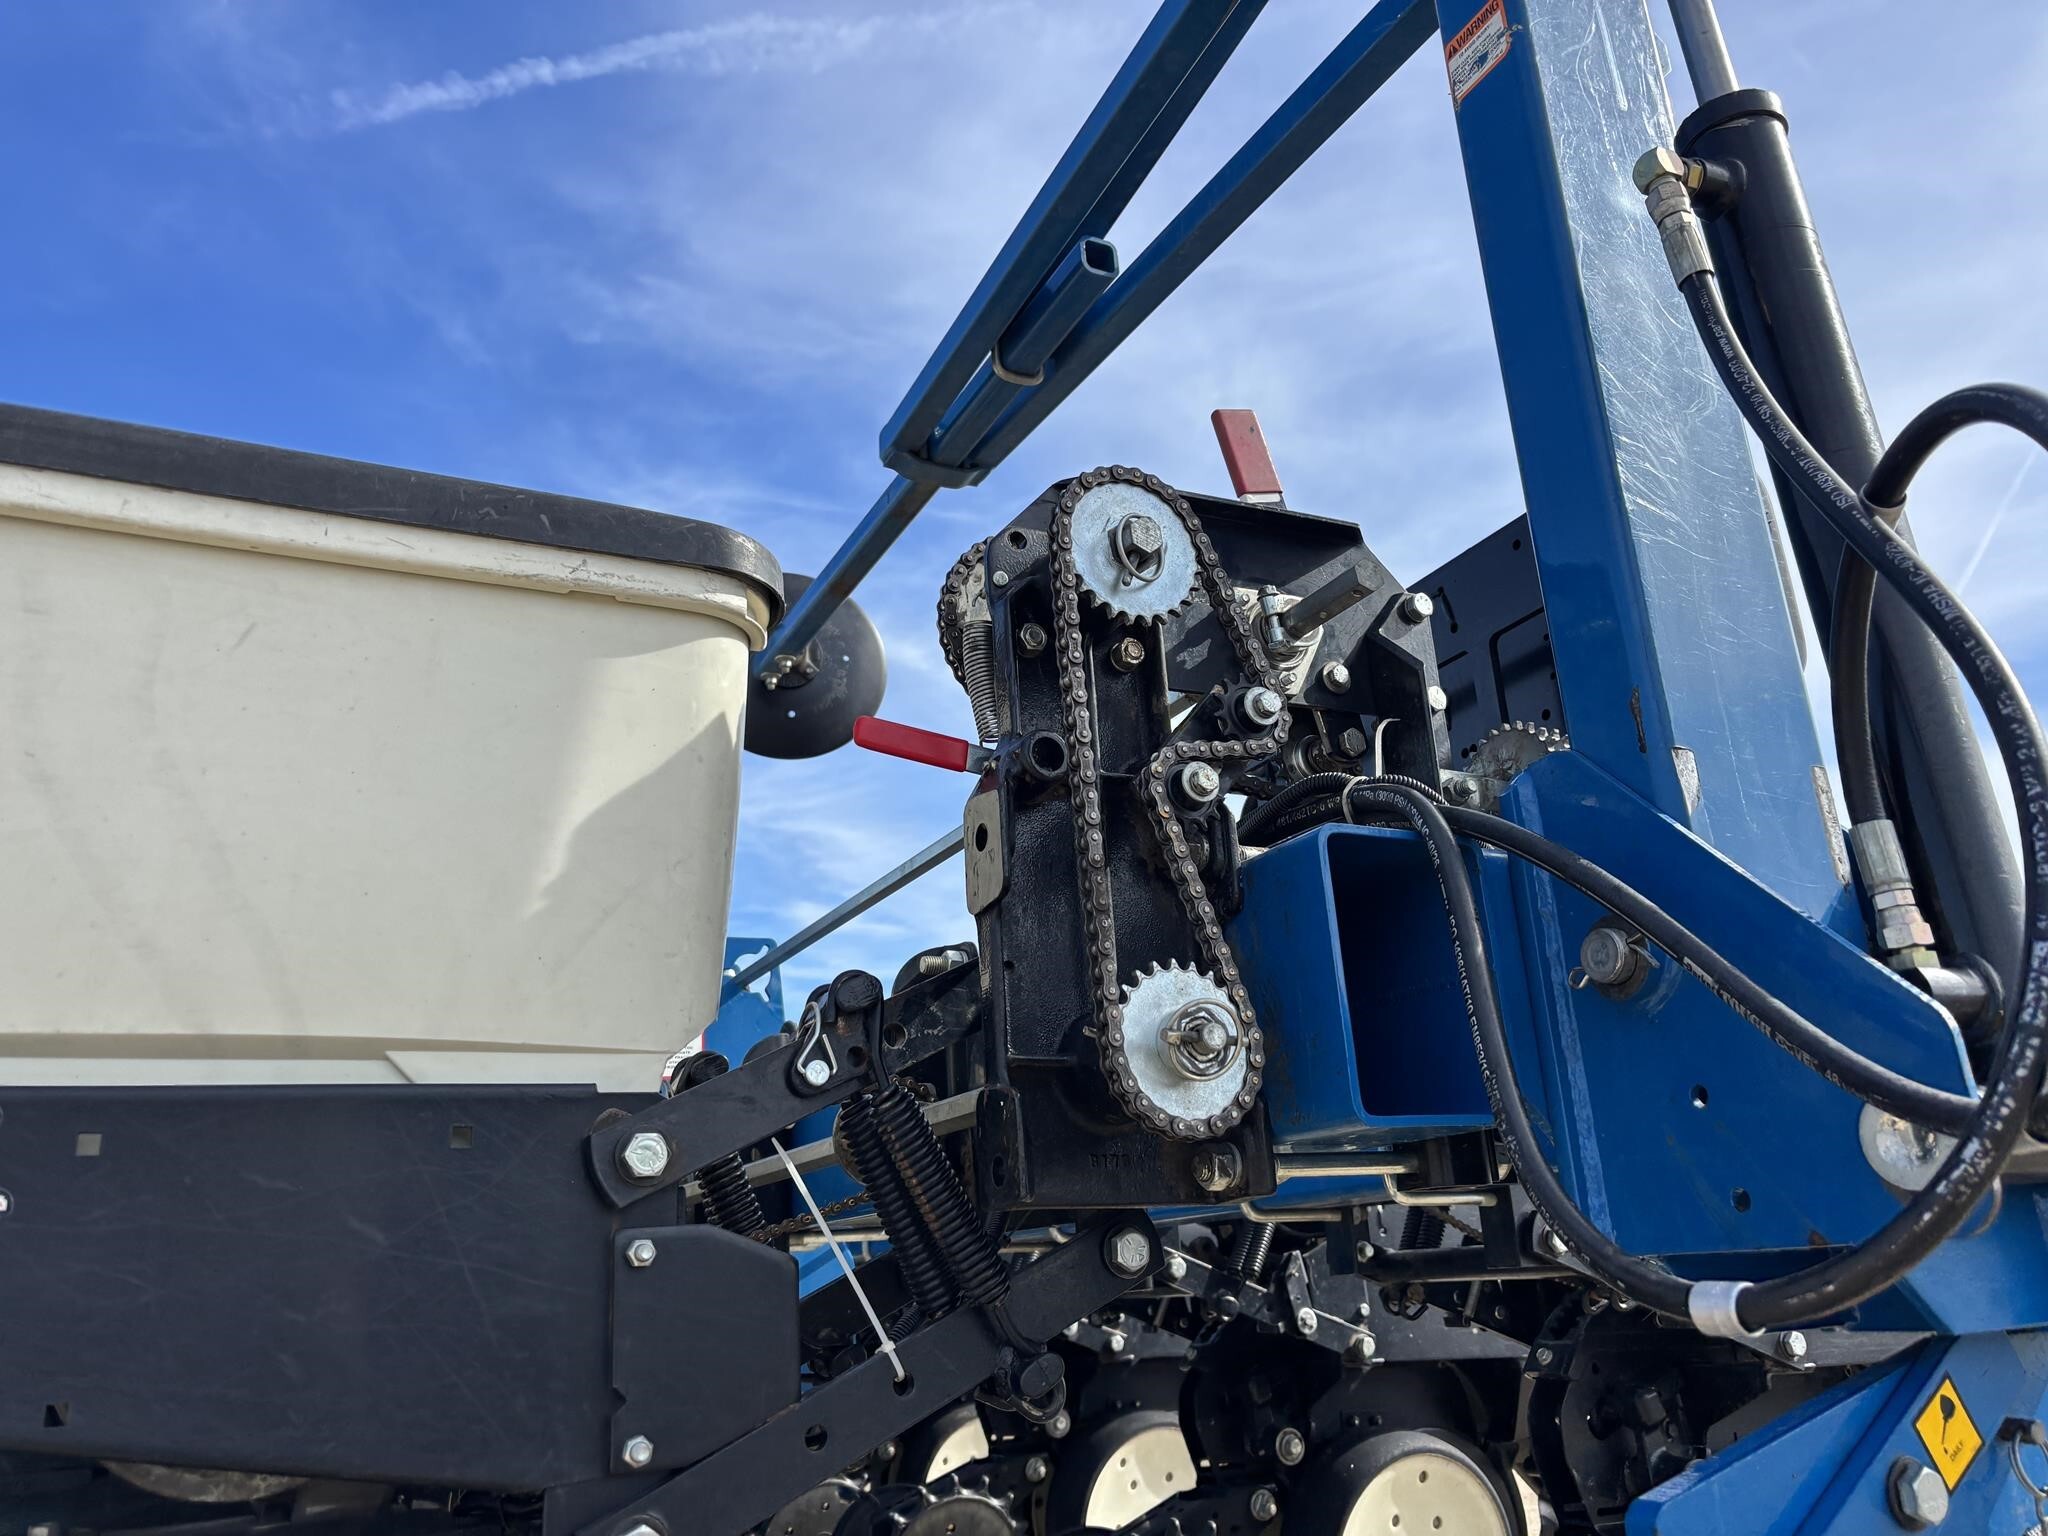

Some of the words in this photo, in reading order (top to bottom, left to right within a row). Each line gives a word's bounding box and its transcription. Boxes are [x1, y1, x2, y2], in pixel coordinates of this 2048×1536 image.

[1456, 0, 1500, 48] WARNING
[1830, 490, 1855, 510] ISO
[1922, 585, 1961, 622] MSHA
